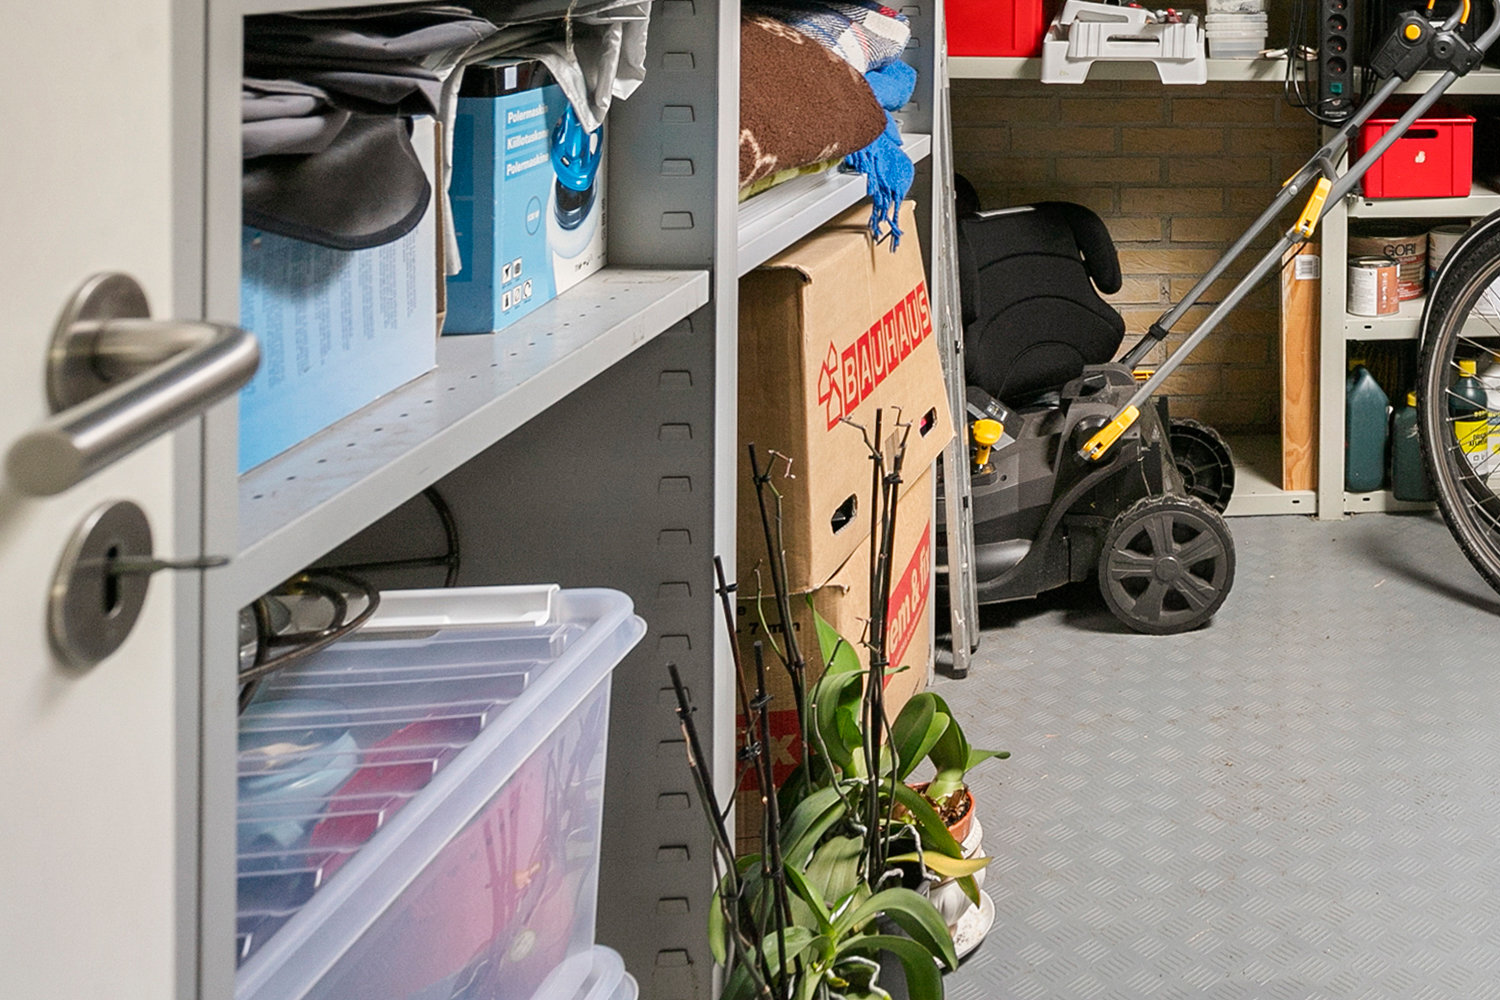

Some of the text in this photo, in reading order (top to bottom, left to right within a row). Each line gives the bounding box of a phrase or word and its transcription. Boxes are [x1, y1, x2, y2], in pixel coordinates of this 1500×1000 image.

[1383, 243, 1416, 256] GORI
[843, 288, 931, 406] BAUHAUS
[888, 544, 931, 654] em & fi
